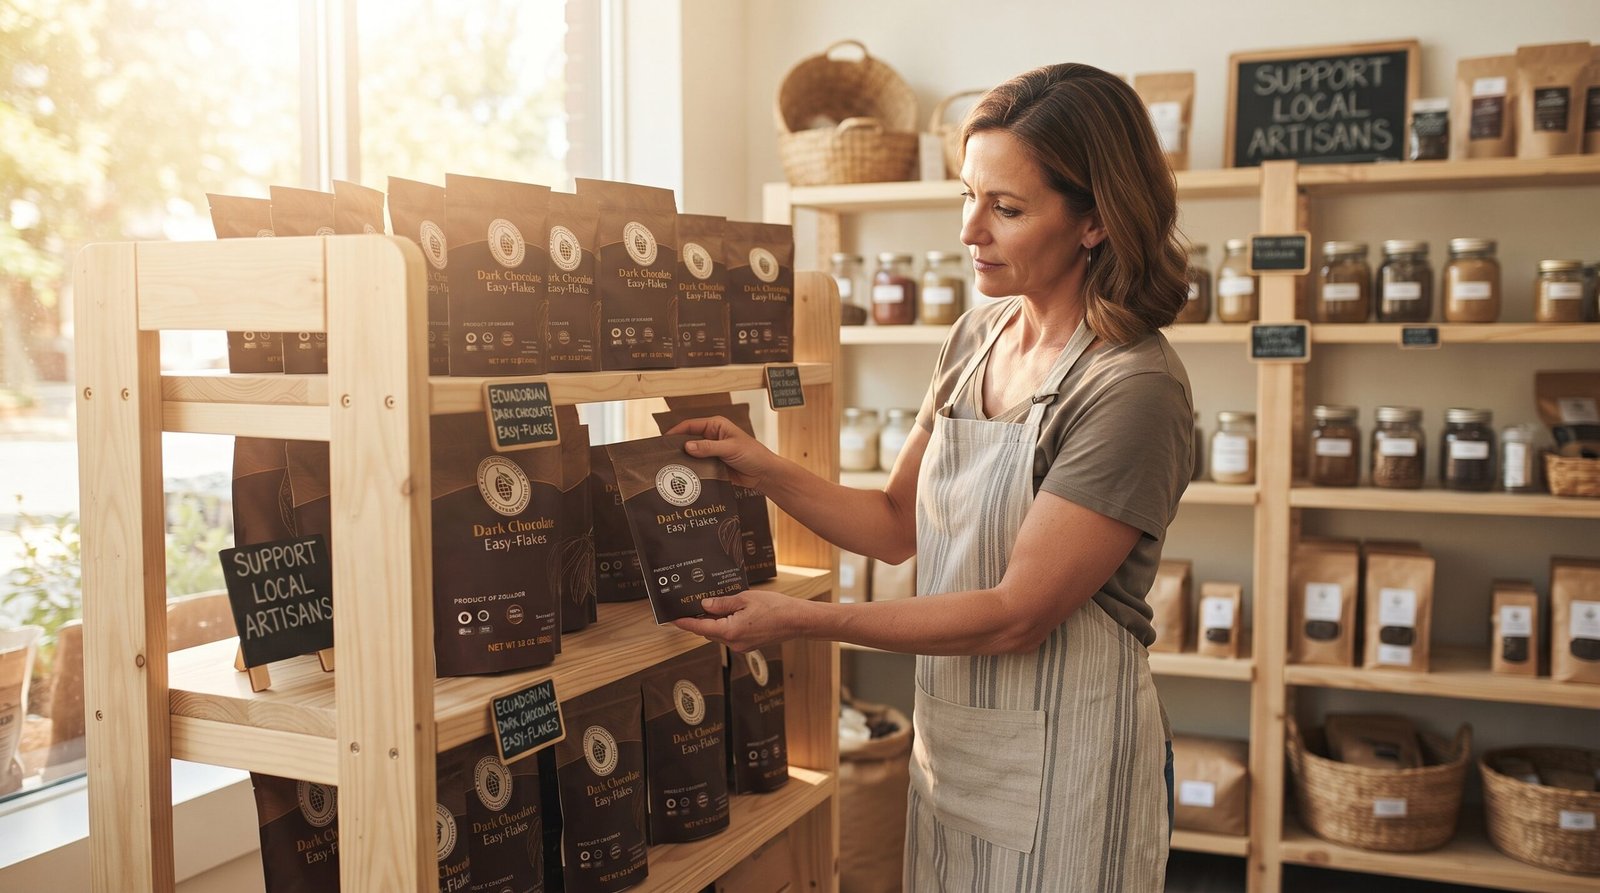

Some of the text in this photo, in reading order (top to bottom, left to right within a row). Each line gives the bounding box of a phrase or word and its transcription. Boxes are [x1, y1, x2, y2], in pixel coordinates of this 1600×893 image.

[1254, 57, 1392, 96] SUPPORT
[1272, 91, 1371, 123] LOCAL
[1247, 118, 1394, 156] ARTISANS
[477, 270, 542, 283] Dark Chocolate
[619, 268, 672, 280] Dark Chocolate
[486, 281, 535, 295] Easy-Flakes
[548, 283, 589, 295] Easy-Flakes
[627, 279, 668, 289] Easy-Flakes
[680, 282, 697, 290] Dark
[686, 291, 722, 301] Easy-Flakes
[490, 386, 547, 404] ECUADORIAN
[493, 405, 553, 421] DARK CHOCOLATE
[498, 423, 554, 441] EASY-FLAKES
[657, 504, 726, 525] Dark Chocolate
[473, 515, 554, 537] Dark Chocolate
[666, 515, 719, 534] Easy-Flakes
[484, 533, 547, 552] Easy-Flakes
[234, 540, 316, 577] SUPPORT
[252, 574, 315, 604] LOCAL
[454, 596, 487, 604] PRODUCT
[681, 594, 694, 604] NET
[246, 597, 333, 640] ARTISANS
[488, 642, 504, 652] NET
[495, 683, 551, 716] ECUADORIAN
[498, 701, 559, 734] DARK CHOCOLATE
[502, 717, 559, 751] EASY-FLAKES
[587, 782, 606, 796] Dark
[594, 786, 633, 808] Easy-Flakes
[473, 804, 537, 834] Dark Chocolate
[296, 833, 322, 852] Dark
[483, 822, 529, 846] Easy-Flakes
[306, 843, 338, 864] Easy-F
[439, 855, 470, 879] Chocol
